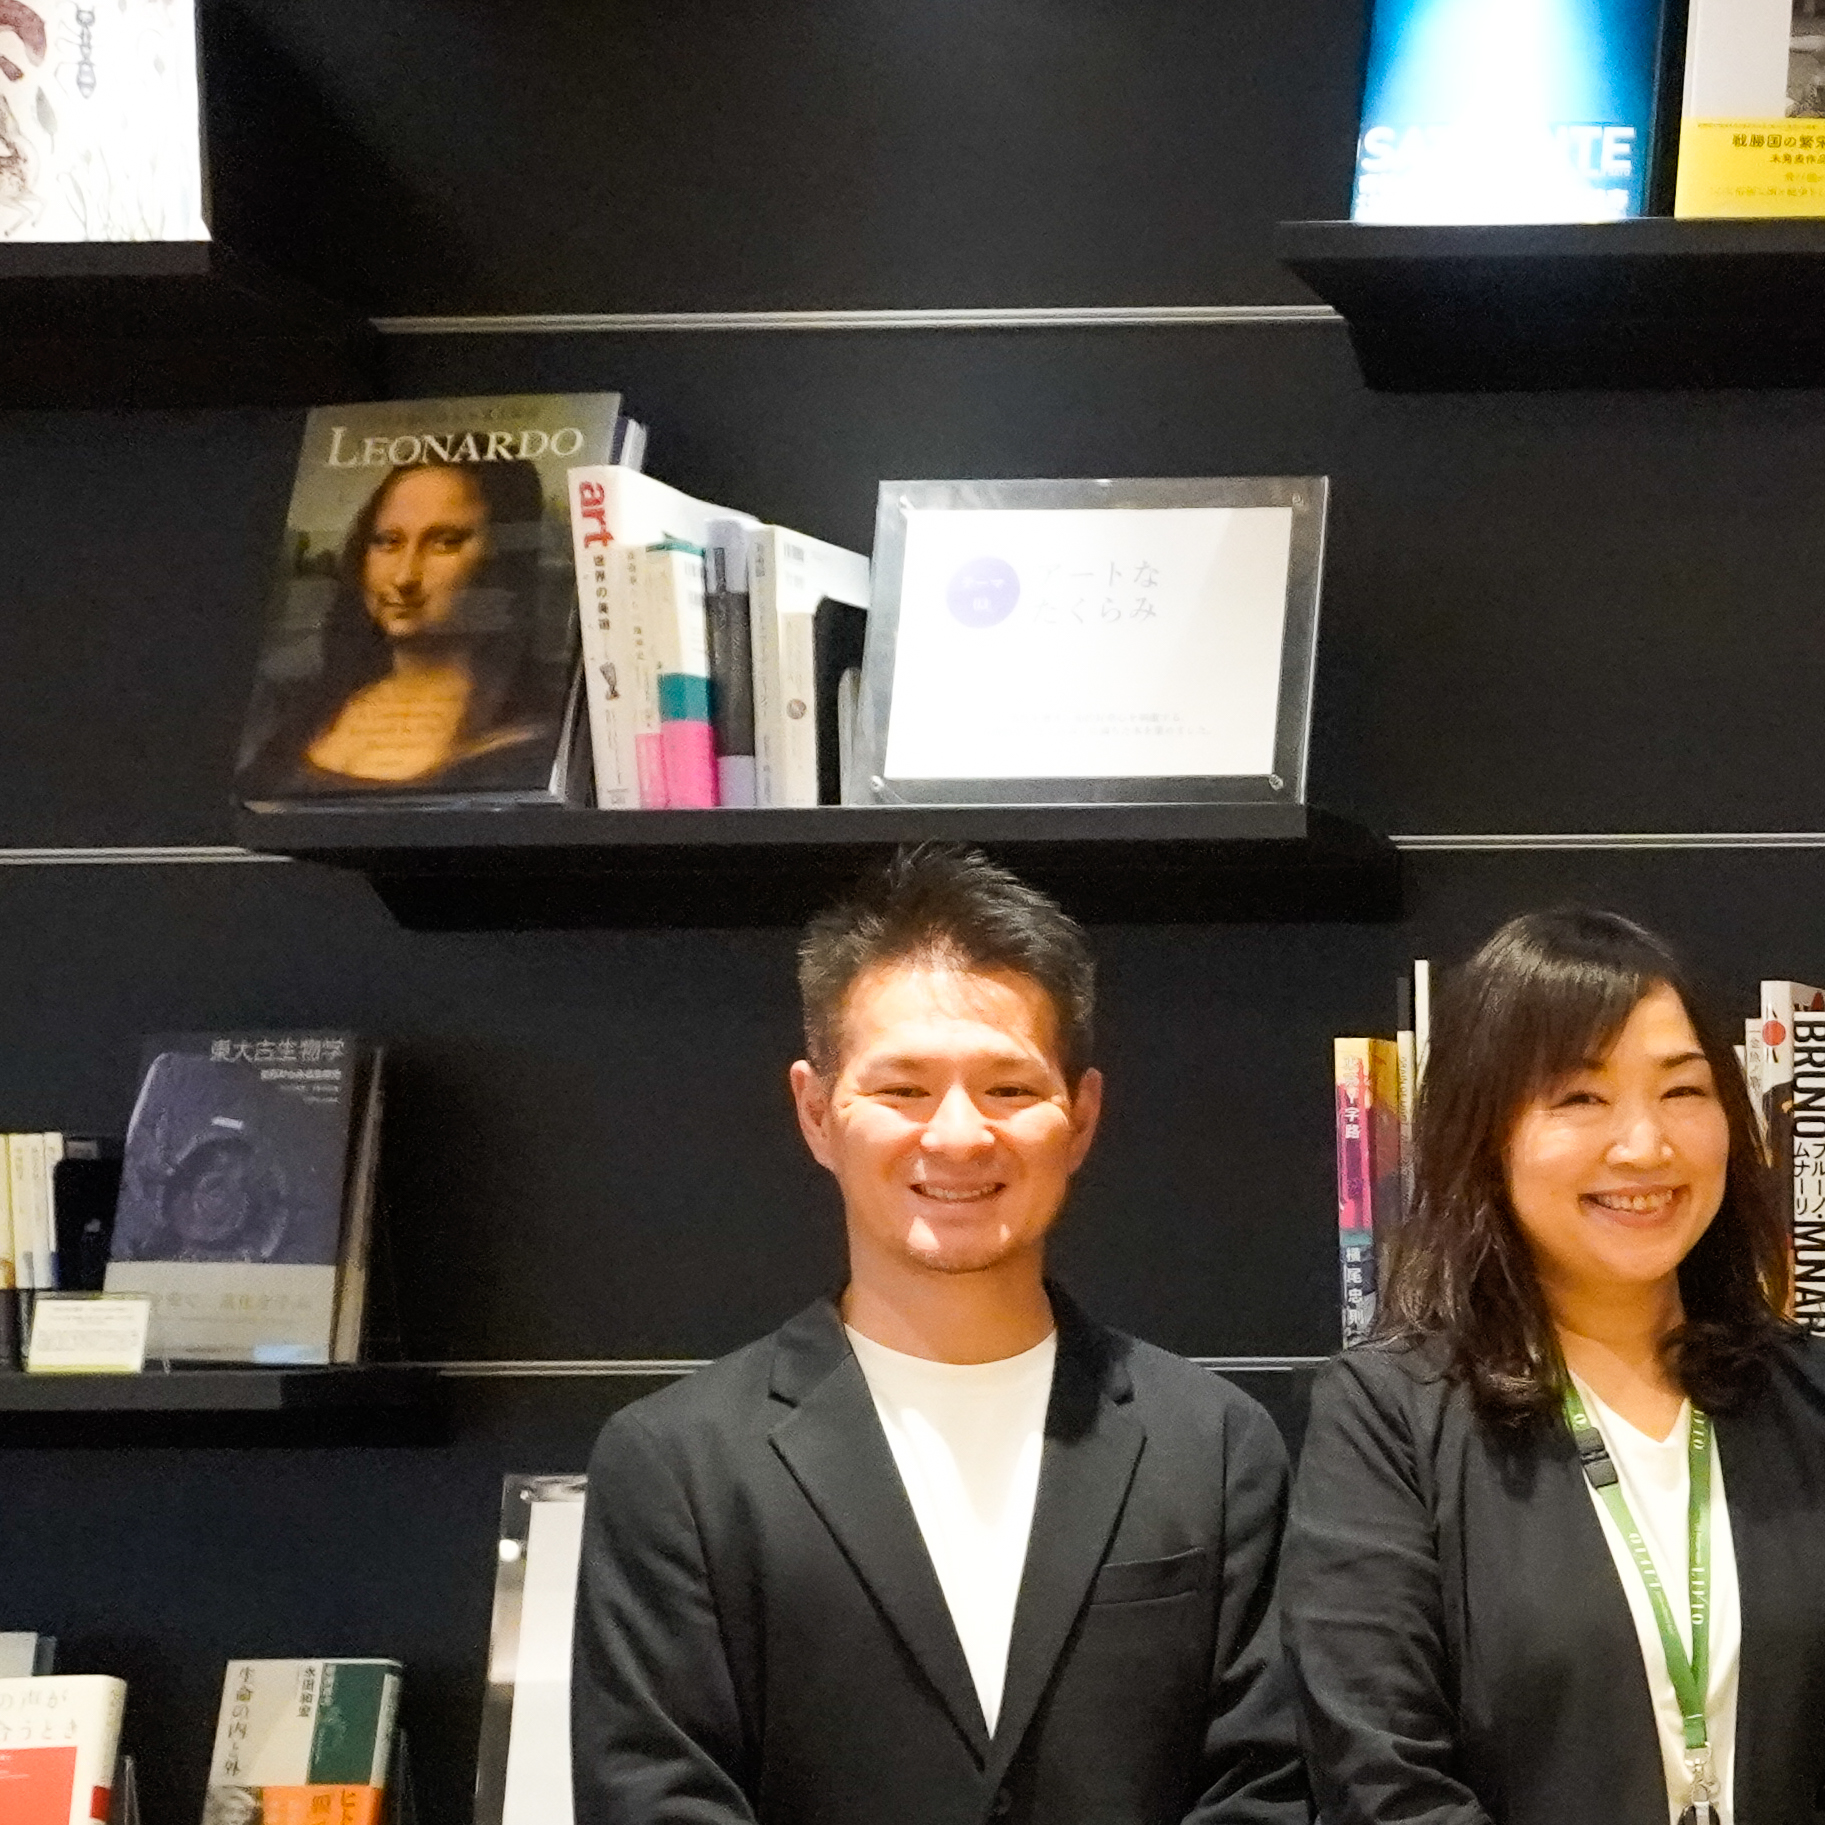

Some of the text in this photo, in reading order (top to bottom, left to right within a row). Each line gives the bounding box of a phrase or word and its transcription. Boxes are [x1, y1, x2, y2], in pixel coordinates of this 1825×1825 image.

[325, 428, 585, 468] LEONARDO
[579, 480, 615, 549] art
[1794, 1142, 1811, 1216] ムナーリ
[1691, 1567, 1706, 1626] LIVIO
